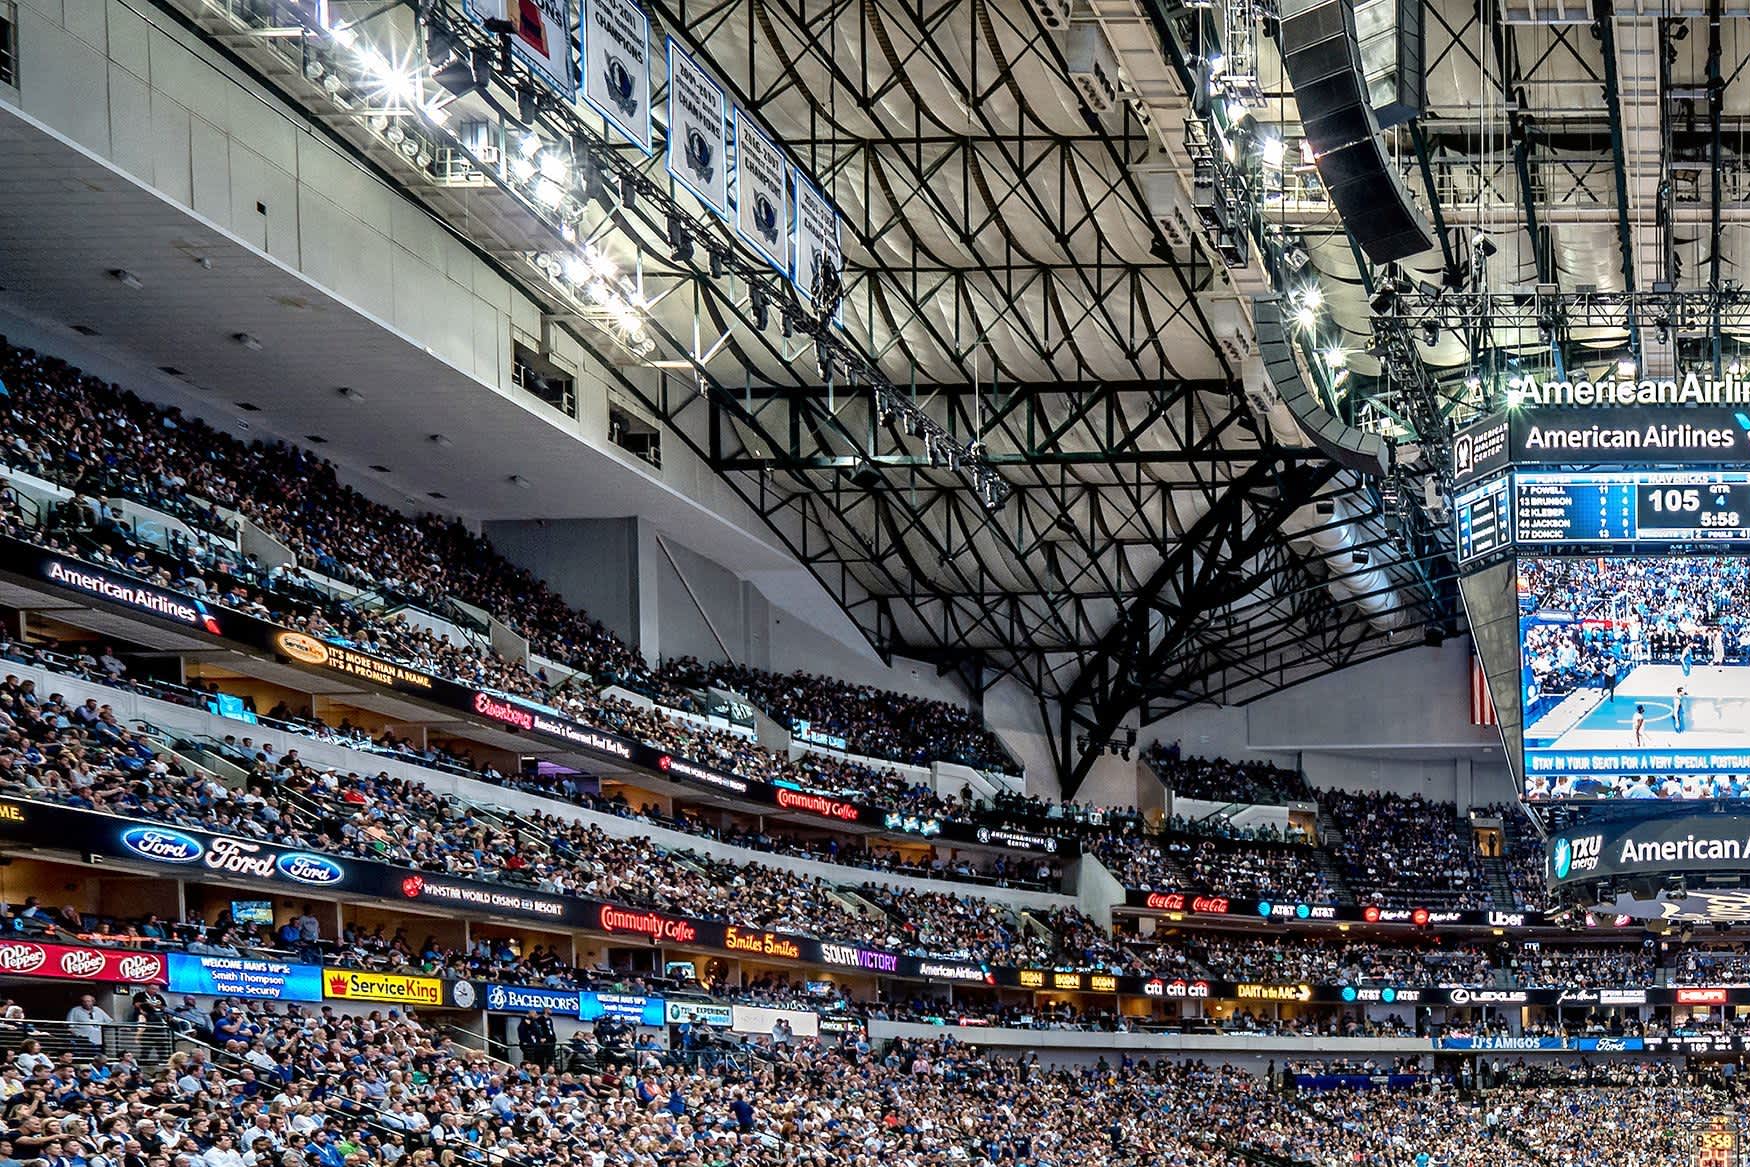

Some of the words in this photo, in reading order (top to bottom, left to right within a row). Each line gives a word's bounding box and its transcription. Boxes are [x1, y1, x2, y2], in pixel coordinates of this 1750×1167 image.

[594, 14, 644, 65] CHAMPIONS
[678, 91, 721, 140] CHAMPIONS
[1525, 425, 1640, 449] American
[1642, 424, 1735, 449] Airlines
[1530, 486, 1565, 495] POWELL
[1710, 485, 1731, 494] QTR
[1530, 497, 1572, 506] BRUNSON
[1648, 489, 1700, 513] 105
[1715, 495, 1725, 506] 4
[1519, 508, 1530, 517] 42
[1530, 508, 1565, 517] KLEBER
[1701, 511, 1740, 527] 5:58
[1530, 519, 1571, 528] JACKSON
[1519, 530, 1530, 539] 77
[1530, 530, 1564, 539] DONCIC
[51, 562, 134, 603] American
[134, 588, 197, 622] Airlines
[328, 647, 344, 660] IT'S
[346, 652, 371, 668] MORE
[373, 660, 395, 677] THAN
[329, 657, 344, 669] IT'S
[355, 666, 392, 685] PROMISE
[1532, 756, 1553, 769] STAY
[1555, 756, 1564, 769] IN
[1567, 756, 1590, 769] YOUR
[1592, 755, 1619, 769] SEATS
[1620, 755, 1638, 769] FOR
[1640, 756, 1648, 768] A
[1651, 756, 1672, 768] VERY
[1674, 755, 1709, 768] SPECIAL
[776, 788, 831, 815] Community
[832, 802, 859, 820] Coffee
[1571, 835, 1602, 859] TXU
[1620, 835, 1743, 863] American
[138, 832, 187, 859] Ford
[205, 837, 276, 878] Ford
[290, 856, 330, 881] Ford
[1571, 855, 1599, 871] energy
[424, 883, 461, 899] WINSTAR
[461, 889, 491, 905] WORLD
[491, 893, 520, 908] CASINO
[534, 902, 562, 915] RESORT
[1272, 904, 1295, 916] AT&T
[1310, 907, 1335, 918] AT&T
[1488, 911, 1525, 926] Uber
[601, 905, 664, 938] Community
[665, 921, 695, 941] Coffee
[13, 944, 29, 956] Dr
[726, 927, 763, 952] 5miles
[764, 934, 799, 958] 5miles
[1, 950, 44, 967] Pepper
[202, 957, 241, 970] WELCOME
[212, 970, 238, 981] Smith
[239, 972, 284, 986] Thompson
[218, 982, 249, 993] Home
[252, 985, 281, 998] Security
[1471, 992, 1527, 1002] LEXUS
[508, 990, 579, 1011] BACHENDORF'S
[1470, 1037, 1493, 1049] JJ'S
[1494, 1037, 1541, 1049] AMIGOS
[1596, 1038, 1626, 1051] Ford
[1703, 1134, 1732, 1149] 5:58
